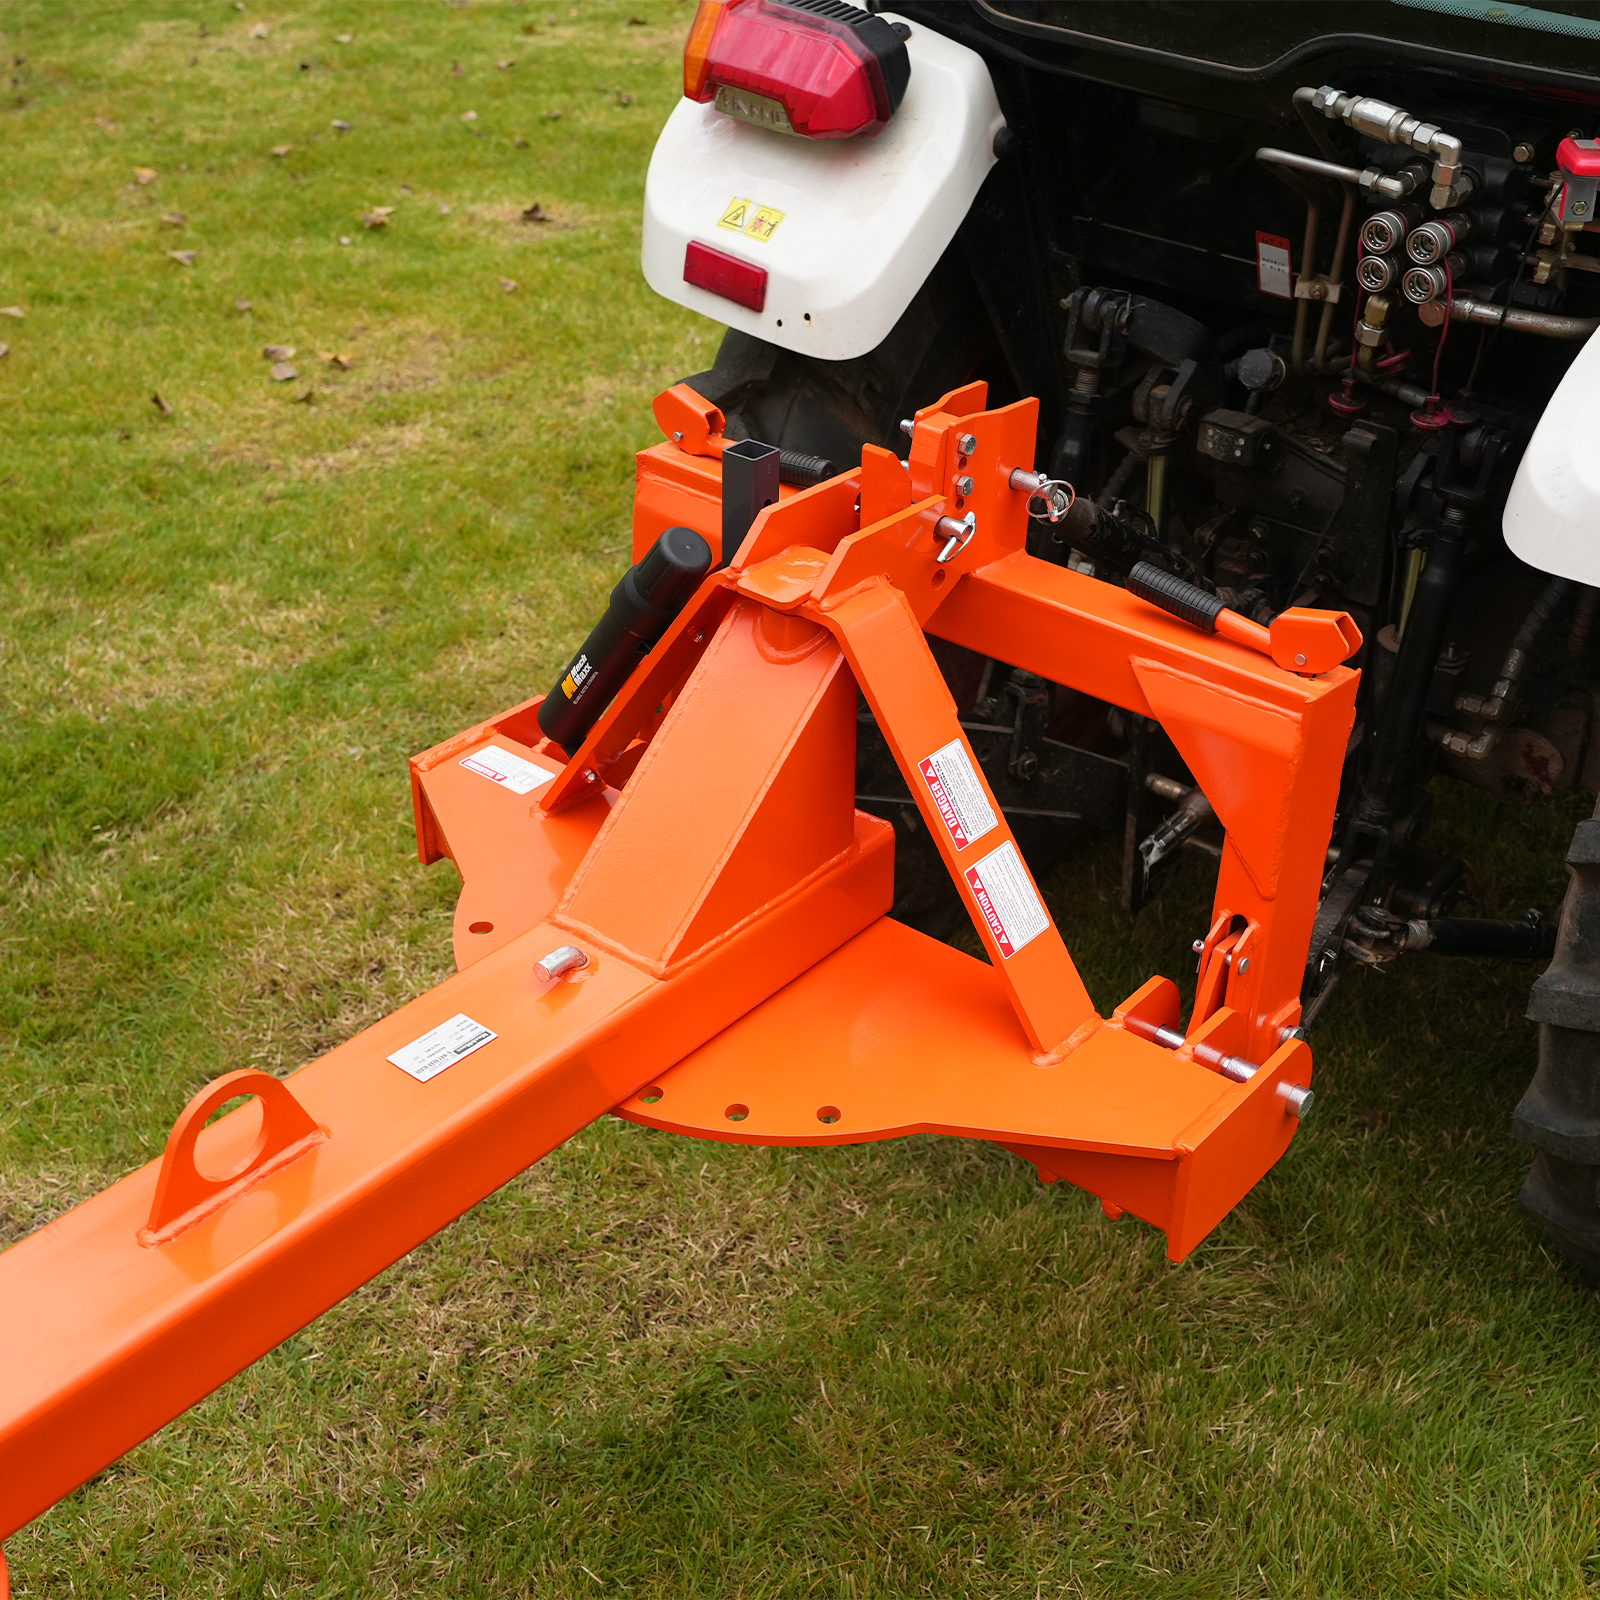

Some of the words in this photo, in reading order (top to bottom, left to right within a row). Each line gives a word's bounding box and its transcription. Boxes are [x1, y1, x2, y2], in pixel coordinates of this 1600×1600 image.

[570, 653, 588, 678] Mech
[573, 661, 593, 687] Maxx
[463, 760, 496, 777] WARNING
[930, 780, 958, 828] DANGER
[977, 890, 1003, 935] CAUTION
